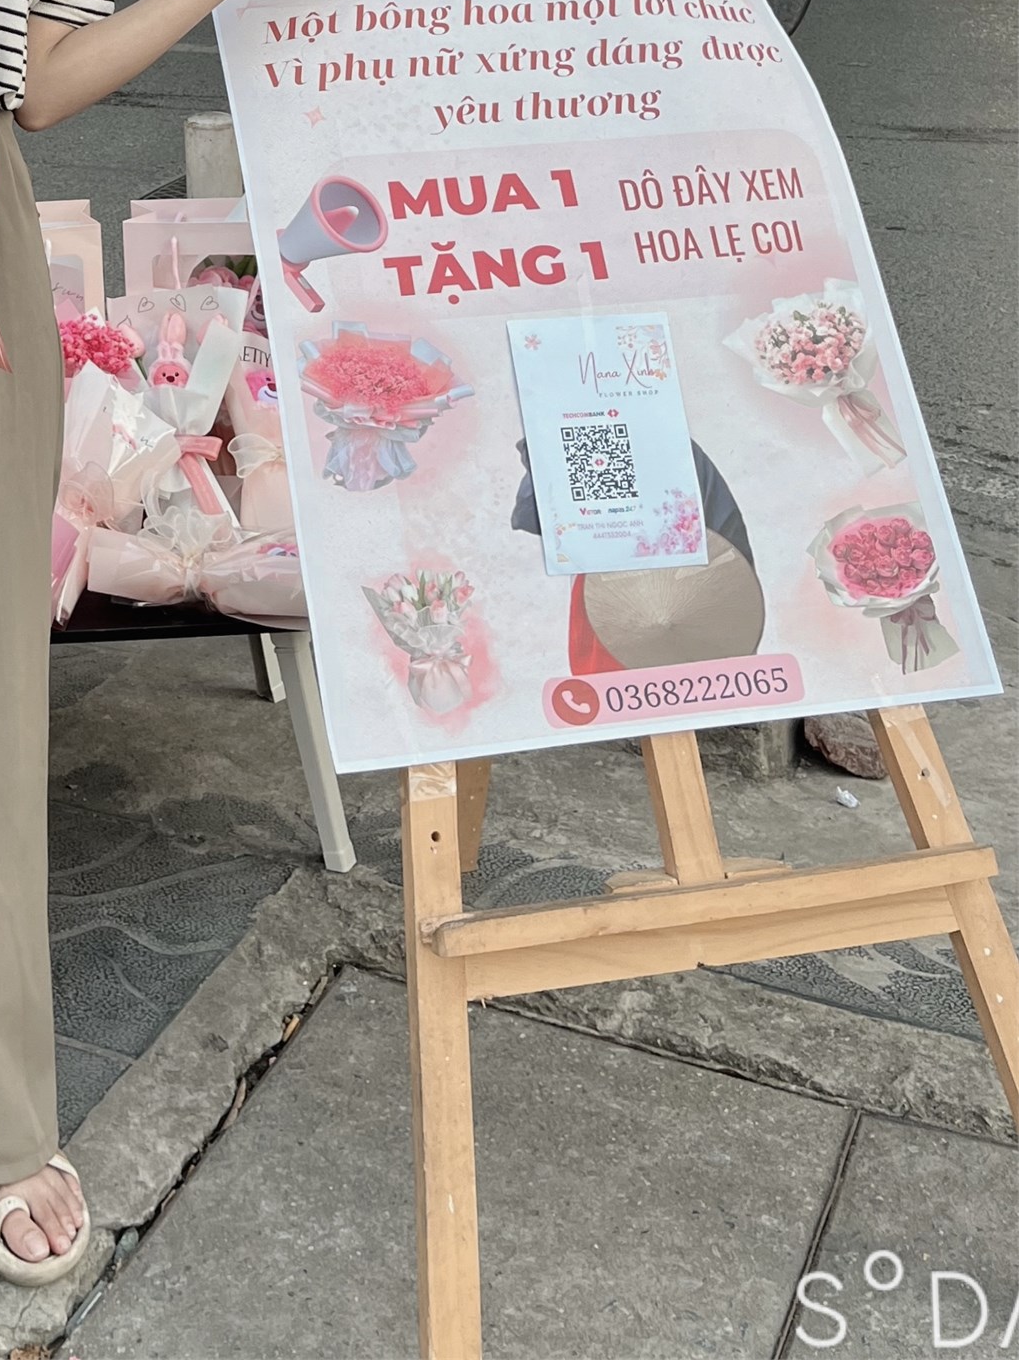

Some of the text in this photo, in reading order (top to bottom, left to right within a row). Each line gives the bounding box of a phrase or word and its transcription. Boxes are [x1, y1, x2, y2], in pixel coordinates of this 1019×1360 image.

[262, 9, 342, 45] Một
[354, 1, 452, 36] bông
[262, 57, 307, 88] Vì
[318, 52, 398, 92] phụ
[408, 47, 464, 78] nữ
[475, 43, 577, 78] xứng
[429, 89, 662, 136] yêu thương
[387, 169, 579, 220] MUA 1
[617, 164, 804, 212] DÔ ĐÂY XEM
[633, 220, 804, 264] HOA LẸ COI
[382, 240, 610, 305] TẶNG 1
[578, 351, 621, 394] Nana
[605, 666, 789, 713] 0368222065
